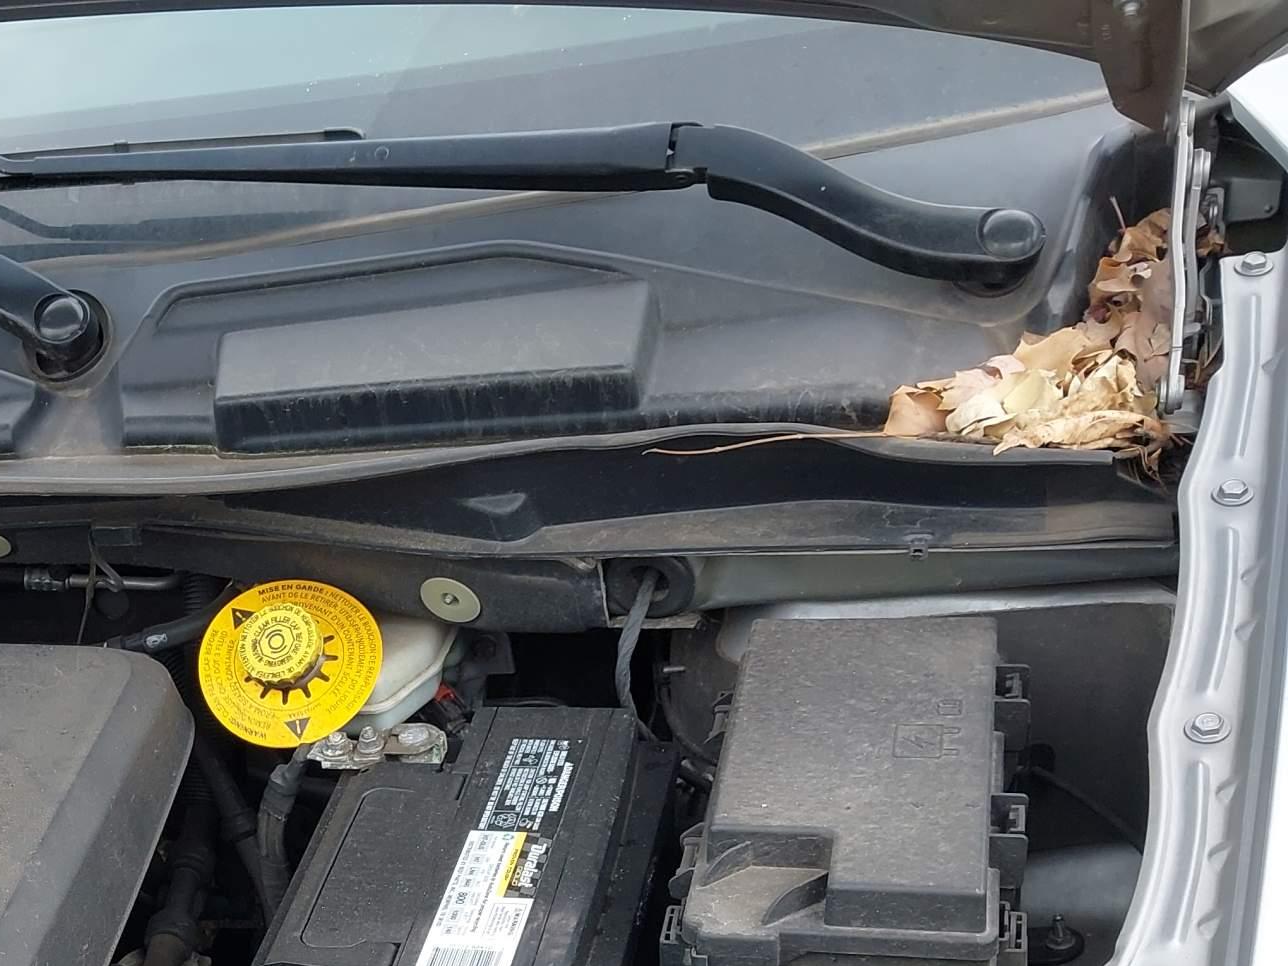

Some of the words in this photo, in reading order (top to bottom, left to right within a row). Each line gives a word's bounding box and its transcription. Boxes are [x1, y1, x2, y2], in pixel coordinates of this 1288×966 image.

[258, 585, 280, 596] MISE
[295, 584, 324, 594] GARDE
[329, 591, 360, 614] NETTOYER
[261, 592, 286, 603] AVANT
[518, 843, 548, 888] Duralast
[512, 866, 523, 886] GOLD
[456, 892, 468, 904] 800
